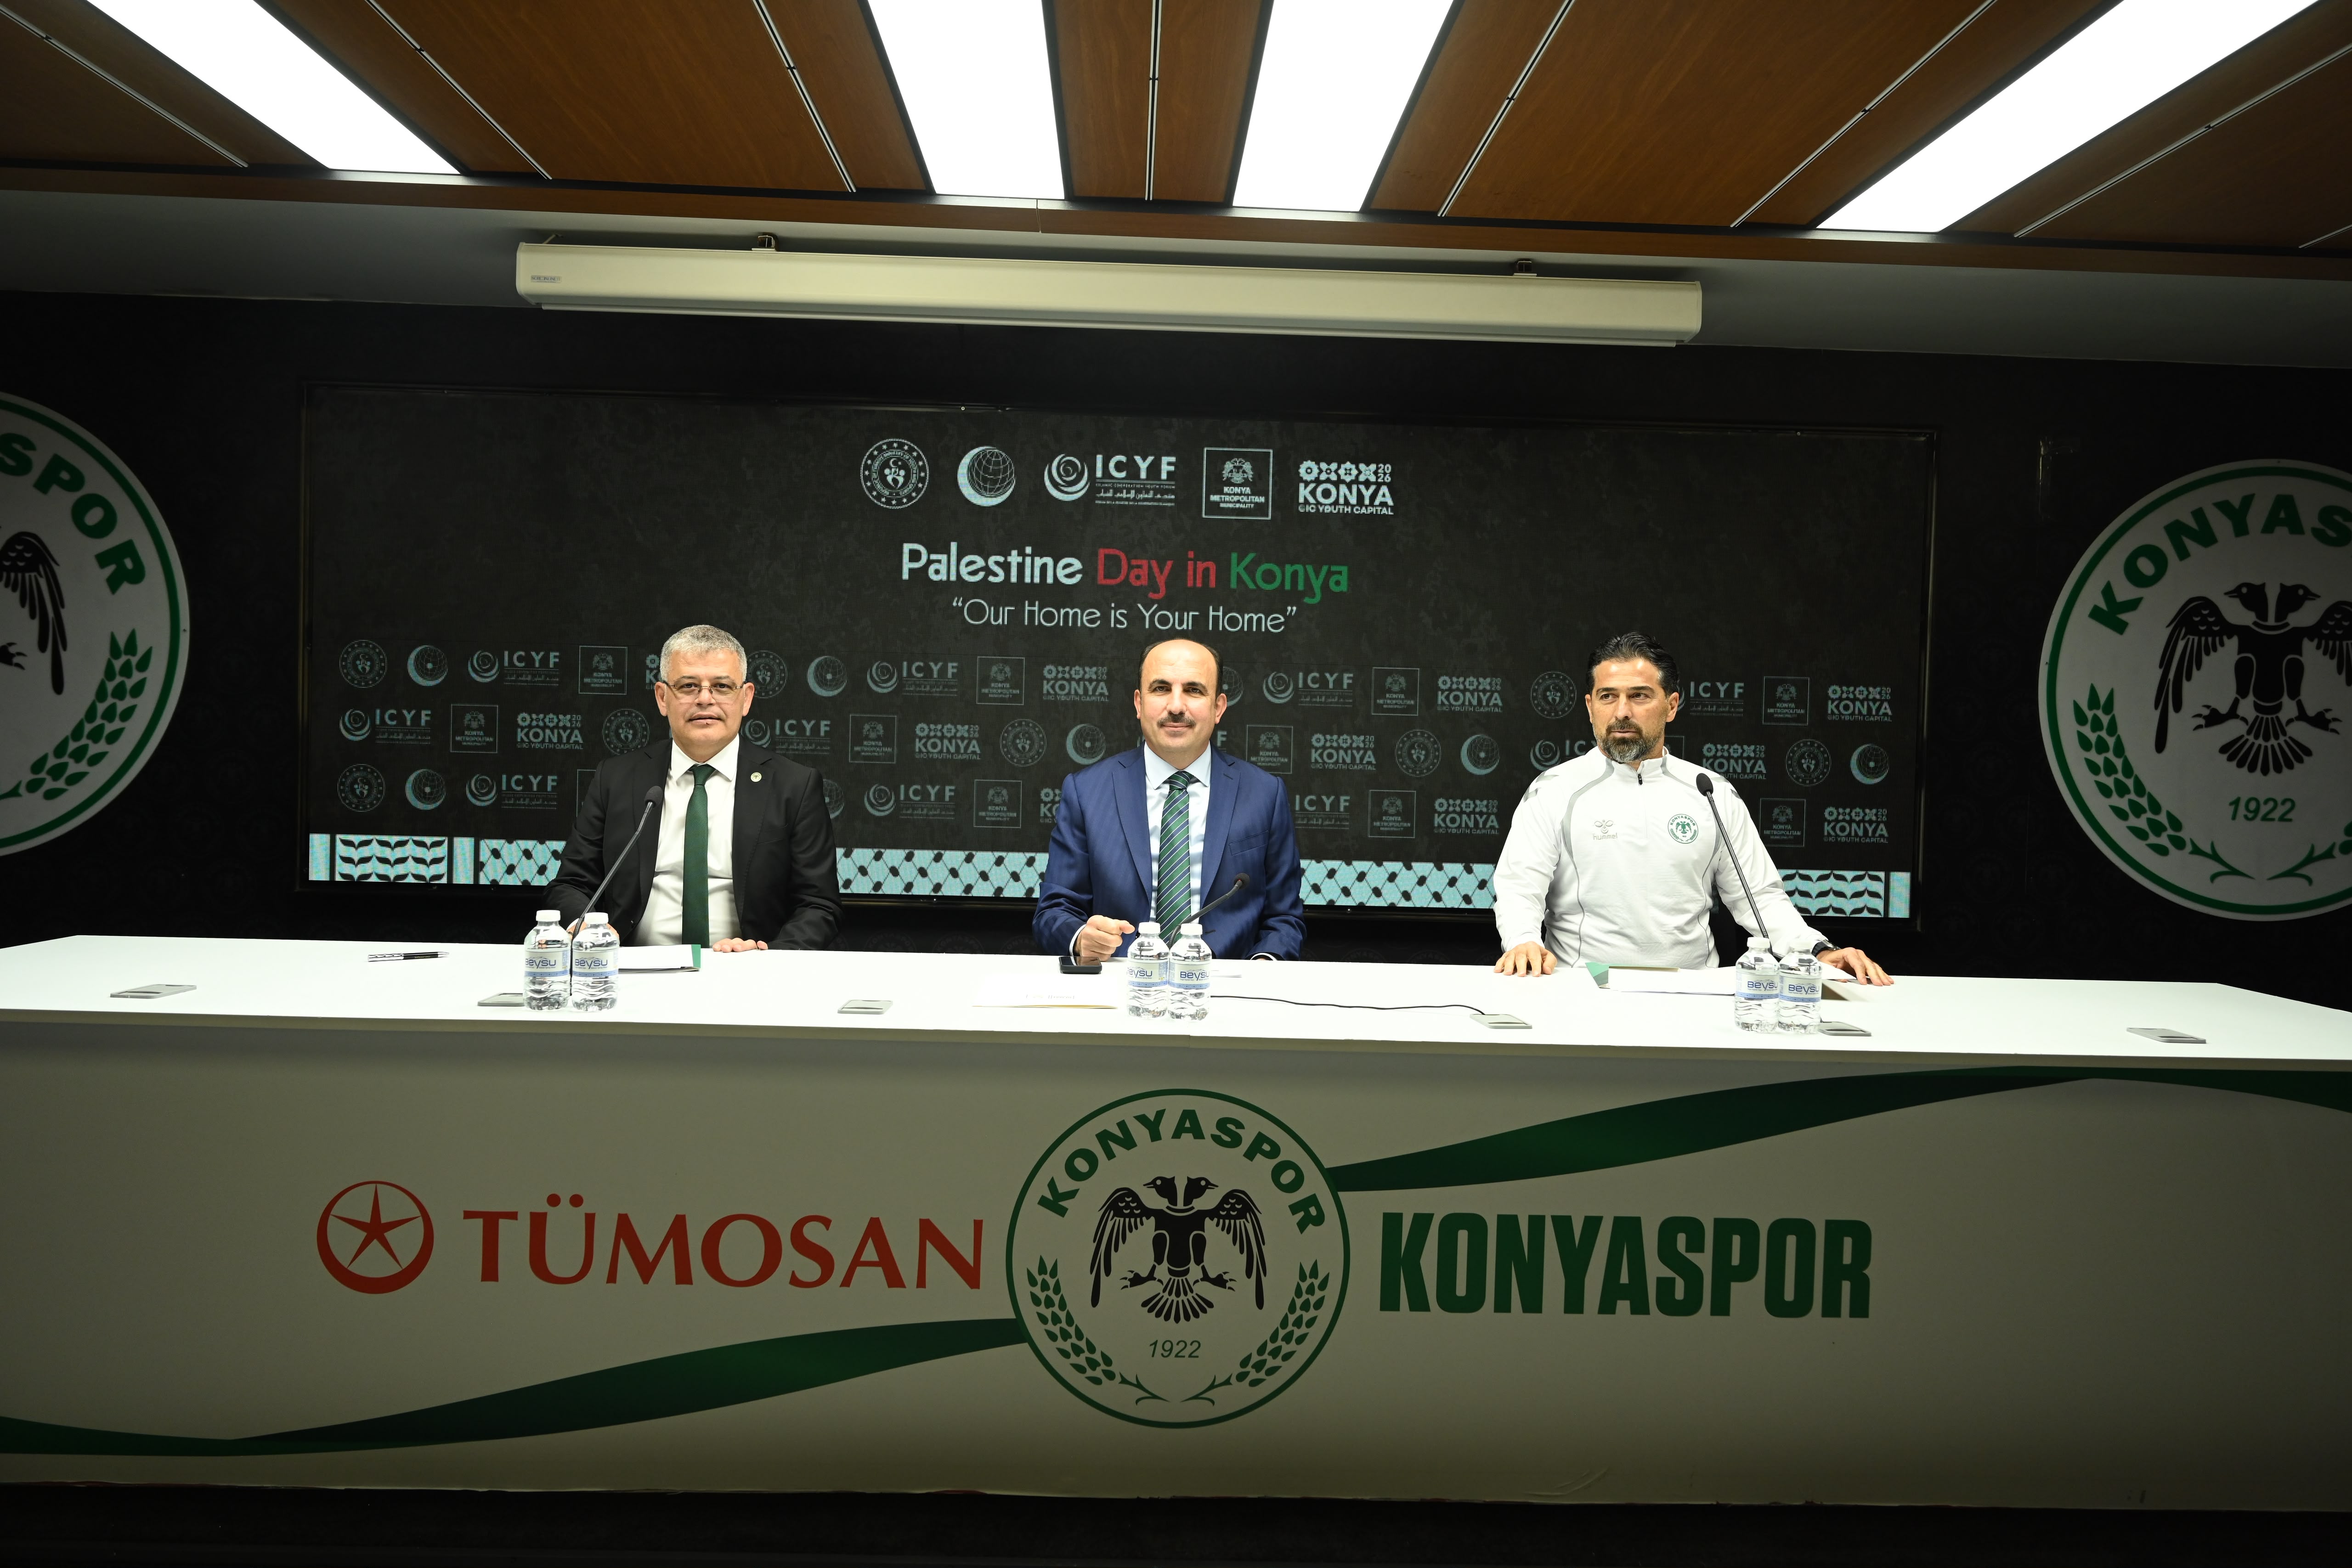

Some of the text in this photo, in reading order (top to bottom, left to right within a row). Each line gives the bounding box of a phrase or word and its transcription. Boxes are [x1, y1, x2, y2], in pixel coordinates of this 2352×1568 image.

[1096, 454, 1176, 480] ICYF
[1378, 463, 1391, 473] 20
[1378, 473, 1391, 482] 26
[1210, 495, 1266, 503] METROPOLITAN
[1299, 483, 1394, 506] KONYA
[1318, 505, 1351, 513] YOUTH
[1353, 506, 1394, 514] CAPITAL
[902, 541, 1348, 604] Palestine Day in Konya
[1024, 601, 1101, 628] Home
[1111, 603, 1128, 629] is
[1143, 604, 1199, 630] Your
[504, 651, 560, 668] ICYF
[902, 661, 958, 679] ICYF
[1043, 680, 1109, 695] KONYA
[1298, 672, 1353, 689] ICYF
[1437, 691, 1502, 706] KONYA
[1690, 682, 1744, 698] ICYF
[1828, 699, 1892, 716] KONYA
[375, 709, 431, 726] ICYF
[517, 728, 583, 743] KONYA
[775, 719, 831, 736] ICYF
[915, 738, 981, 753] KONYA
[1311, 749, 1376, 764] KONYA
[1702, 758, 1767, 773] KONYA
[502, 774, 558, 791] ICYF
[900, 784, 956, 801] ICYF
[1295, 795, 1351, 812] ICYF
[2228, 796, 2296, 822] 1922
[1434, 813, 1499, 828] KONYA
[1670, 816, 1696, 826] KONYASPOR
[1824, 822, 1888, 837] KONYA
[1037, 1108, 1325, 1235] KONYASPOR
[463, 1194, 983, 1290] TÜMOSAN
[1380, 1212, 1872, 1318] KONYASPOR
[1148, 1340, 1201, 1358] 1922
